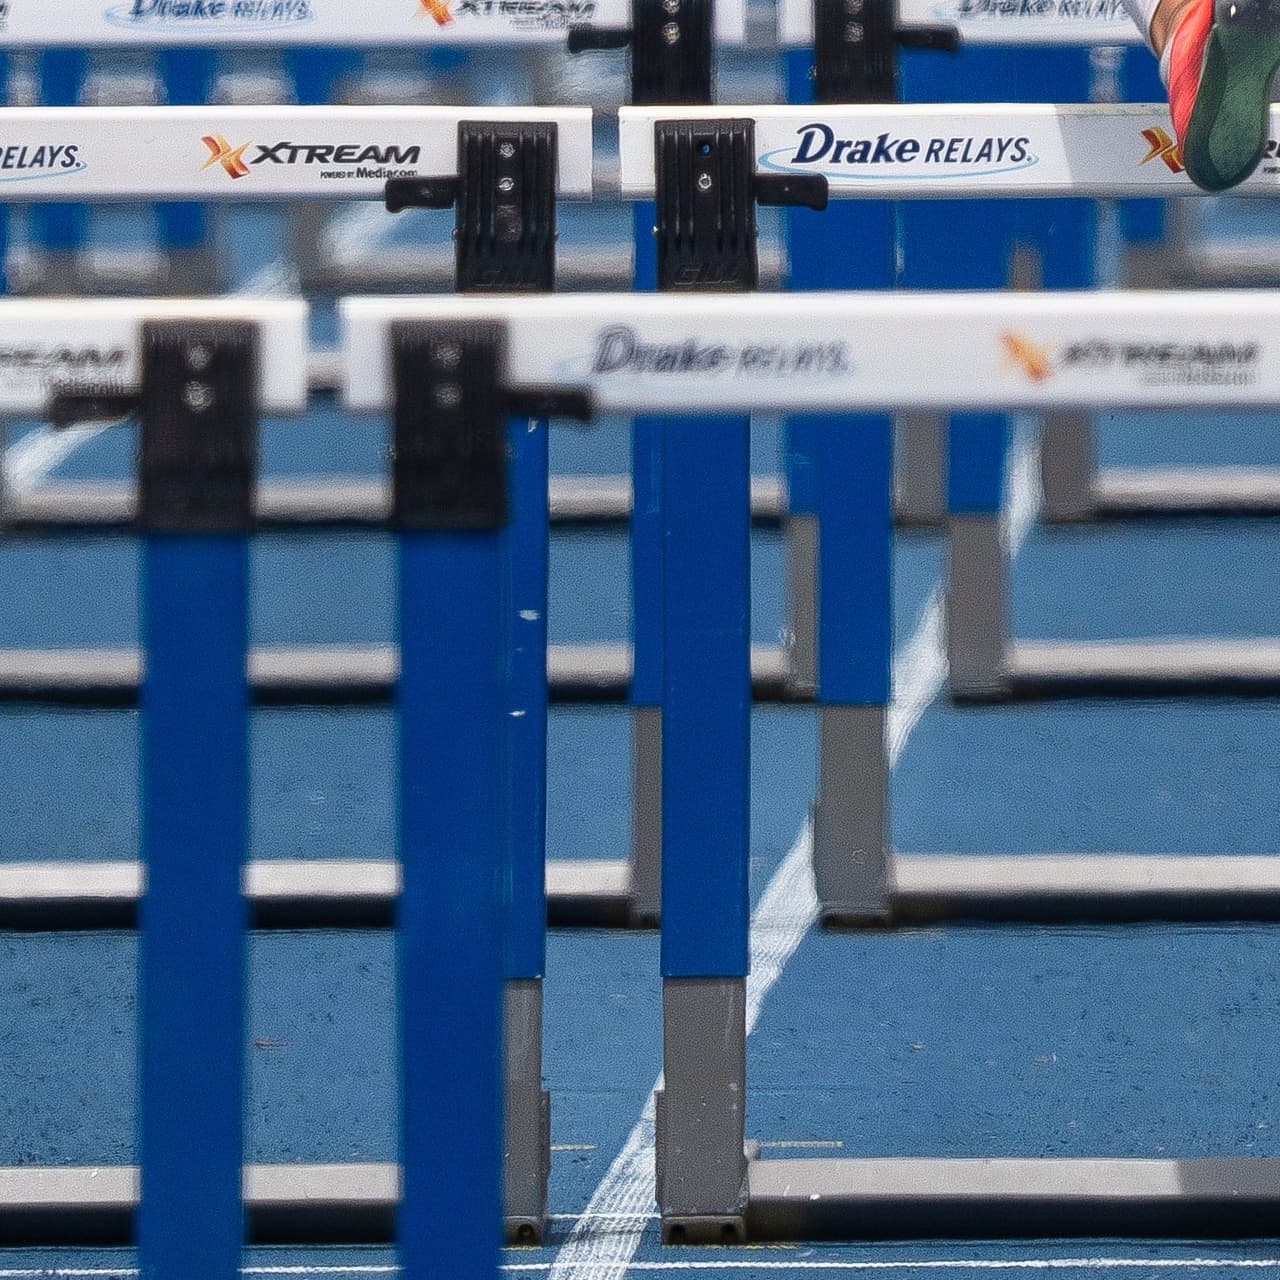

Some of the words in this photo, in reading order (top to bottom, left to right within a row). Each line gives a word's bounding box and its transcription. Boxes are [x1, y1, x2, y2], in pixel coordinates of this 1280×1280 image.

[249, 141, 421, 165] XTREAM
[790, 122, 921, 164] Drake
[0, 144, 82, 170] ELAYS.
